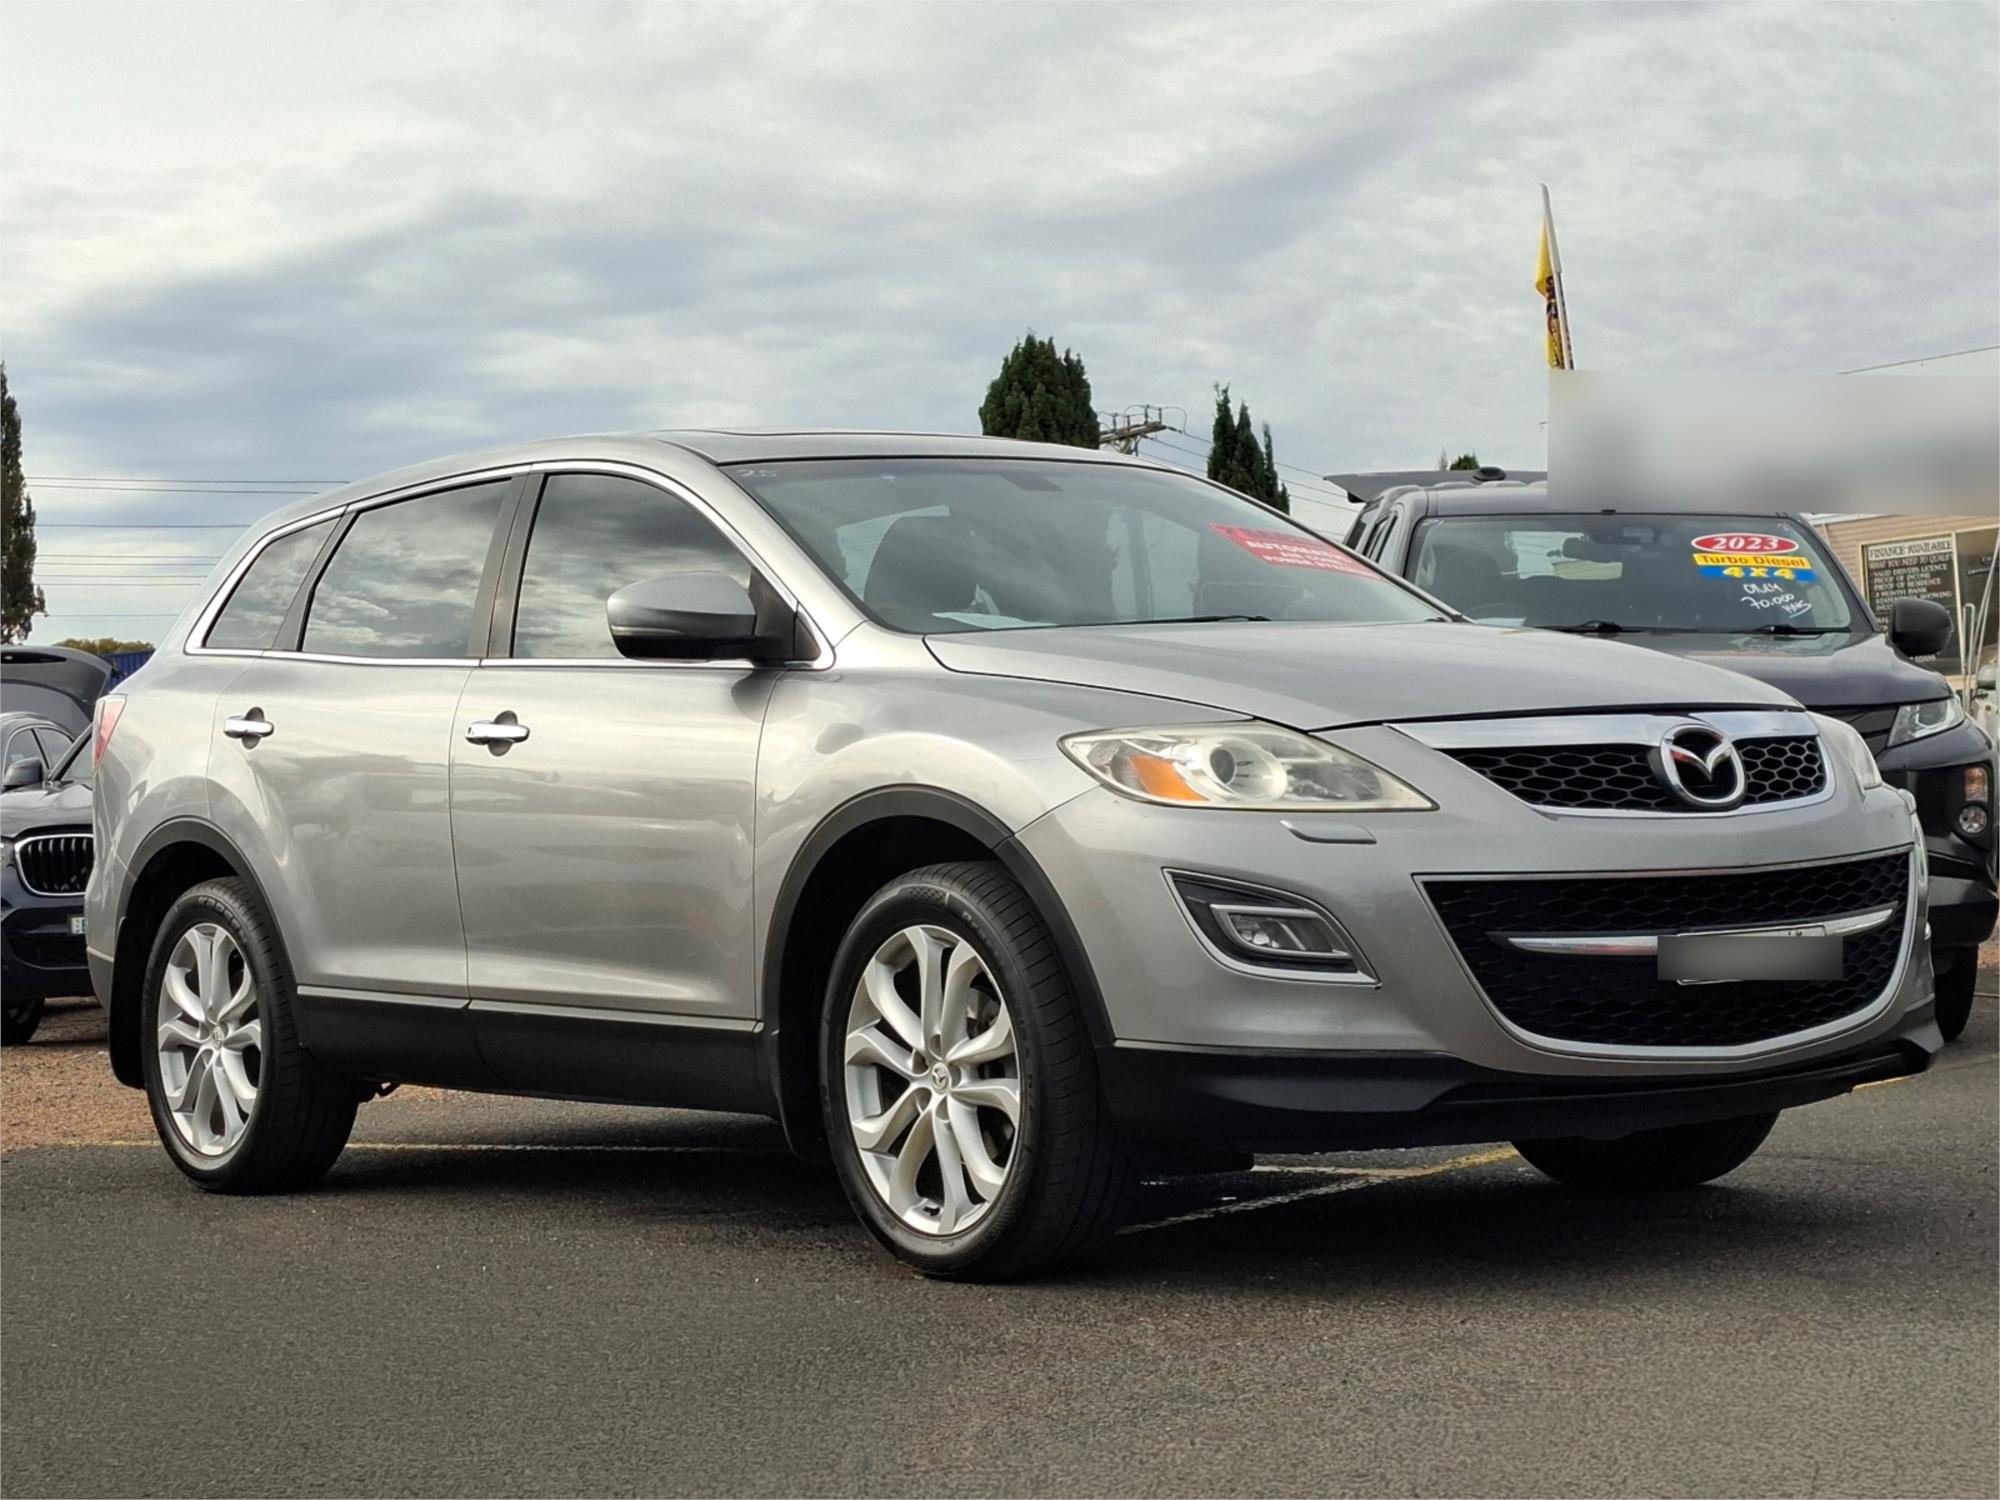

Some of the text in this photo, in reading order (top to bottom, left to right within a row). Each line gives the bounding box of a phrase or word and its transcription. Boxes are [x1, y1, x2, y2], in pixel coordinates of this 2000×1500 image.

[1711, 536, 1778, 550] 2023
[1869, 540, 1953, 558] FINANCE AVAILABLE
[1701, 555, 1806, 567] Turbo Diesel
